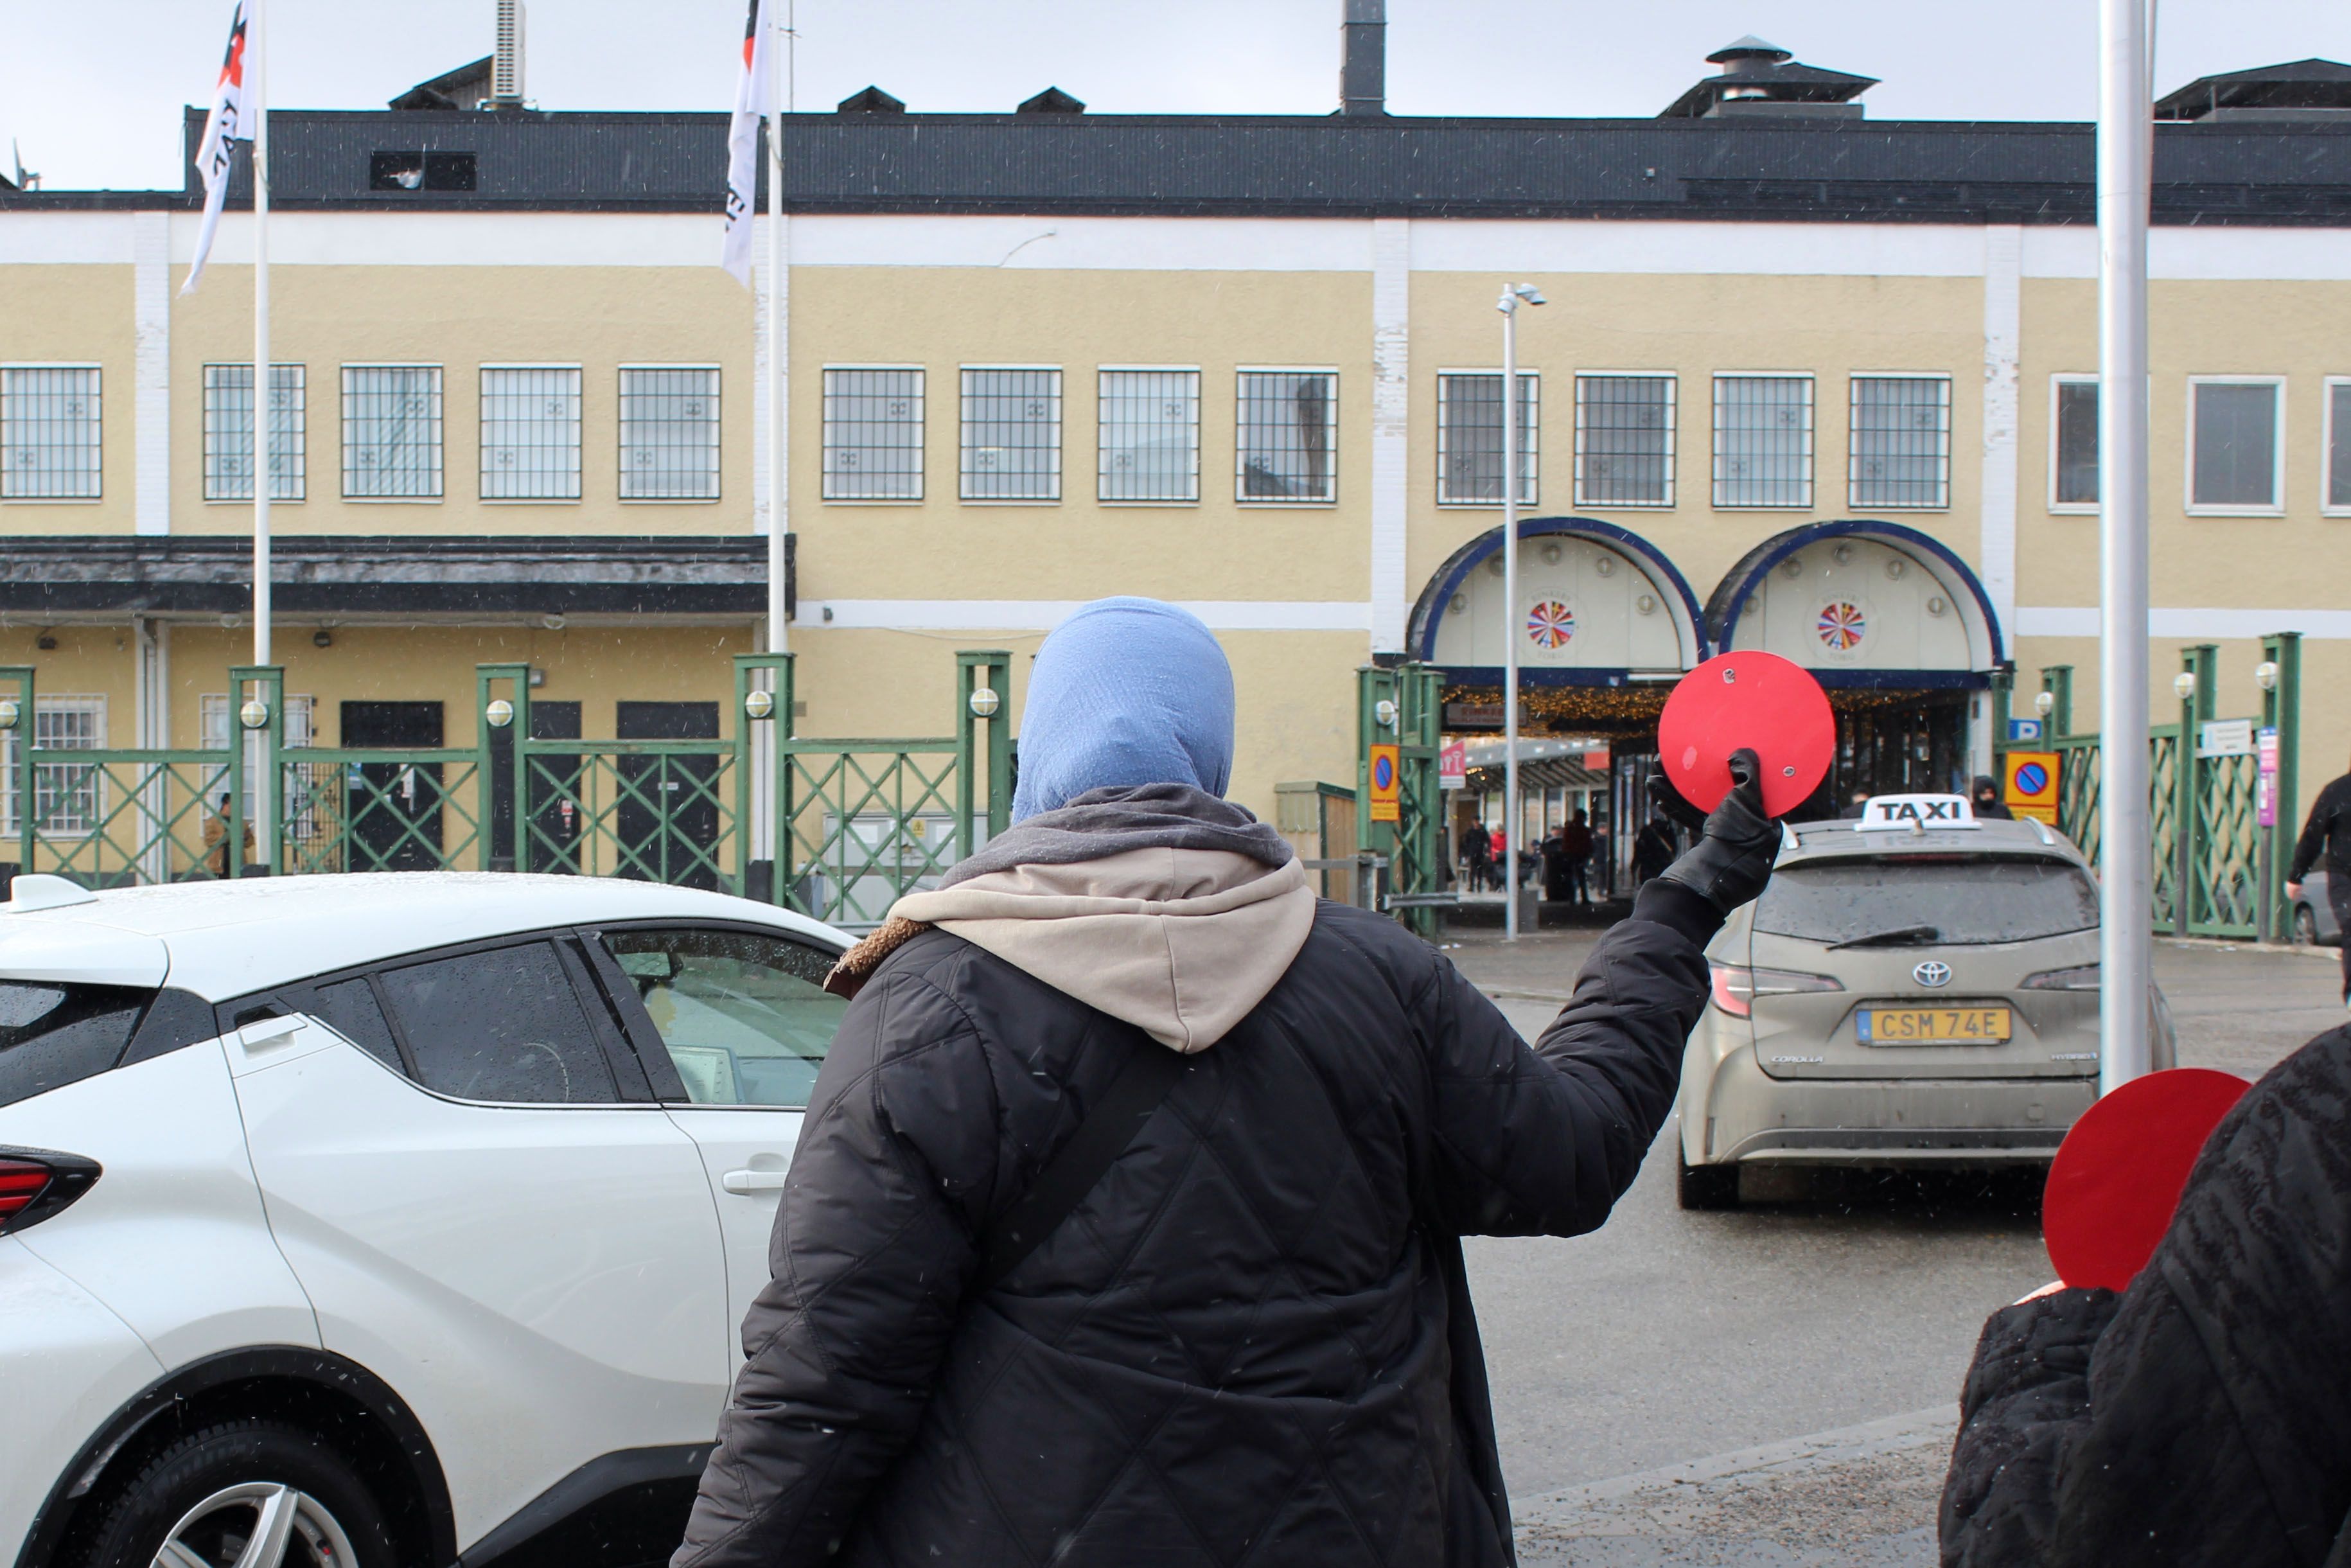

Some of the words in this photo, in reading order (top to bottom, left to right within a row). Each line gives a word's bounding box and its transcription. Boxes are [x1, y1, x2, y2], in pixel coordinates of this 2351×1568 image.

[2019, 722, 2038, 739] P
[1877, 802, 1961, 820] TAXI
[1881, 1013, 1933, 1037] CSM
[1946, 1012, 1997, 1036] 74E
[1770, 1055, 1824, 1064] COROLLA
